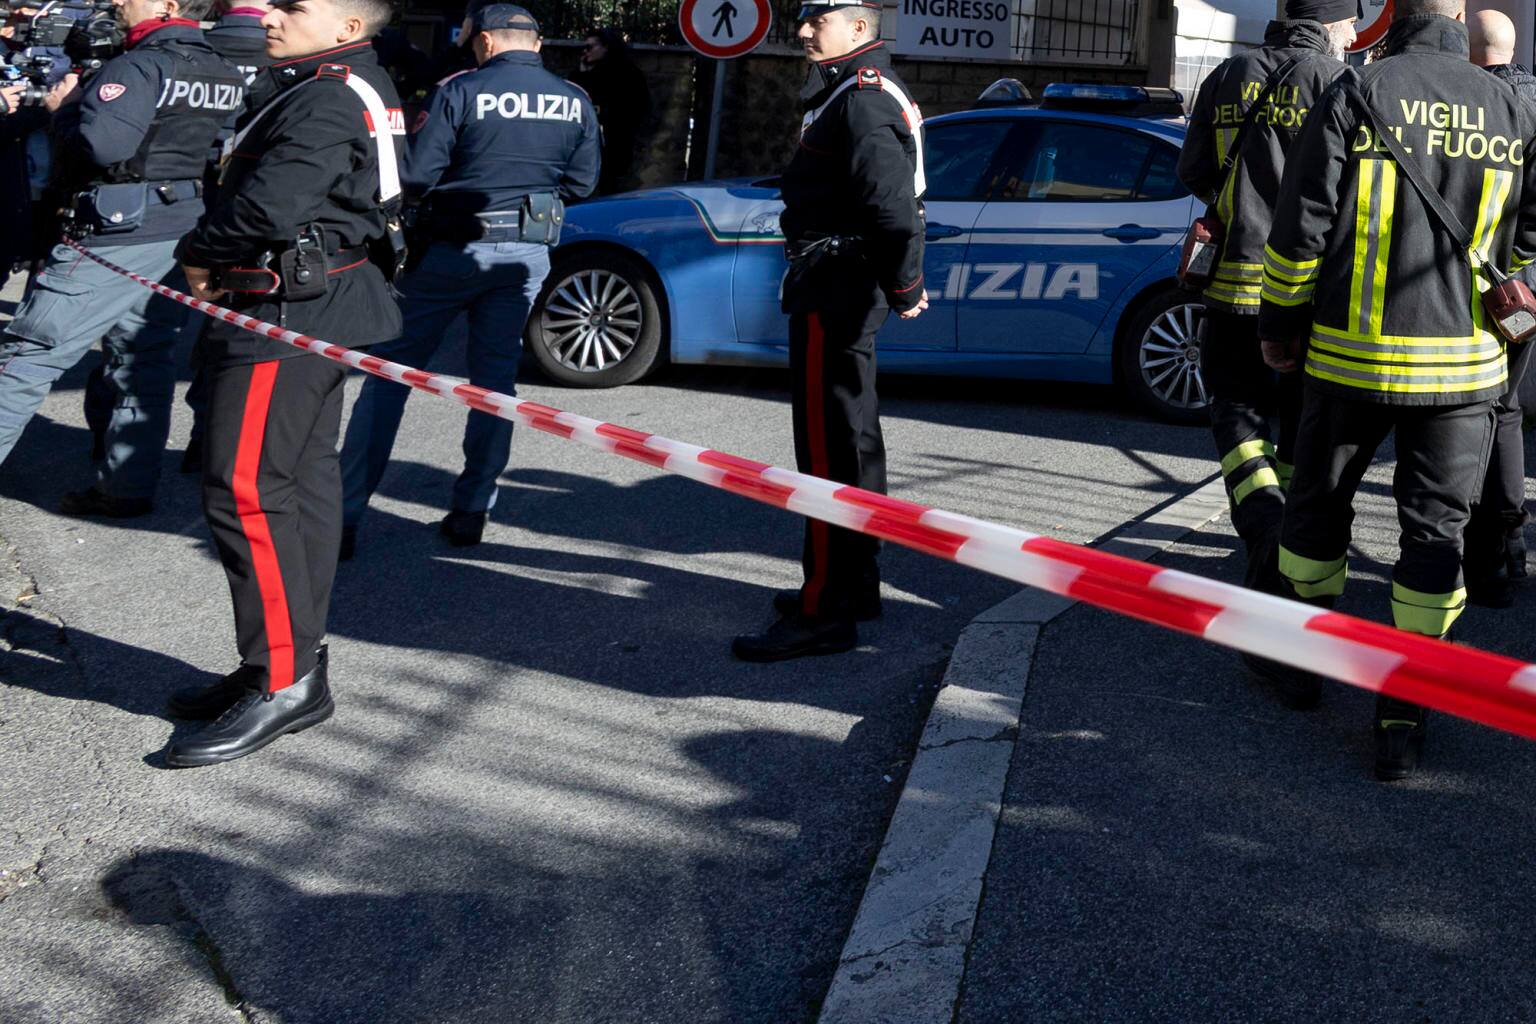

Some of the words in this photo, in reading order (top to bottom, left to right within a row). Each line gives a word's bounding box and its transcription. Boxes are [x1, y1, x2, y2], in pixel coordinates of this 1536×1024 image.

[919, 26, 994, 49] AUTO
[476, 91, 582, 124] POLIZIA
[1400, 98, 1485, 131] VIGILI
[1426, 128, 1524, 166] FUOCO
